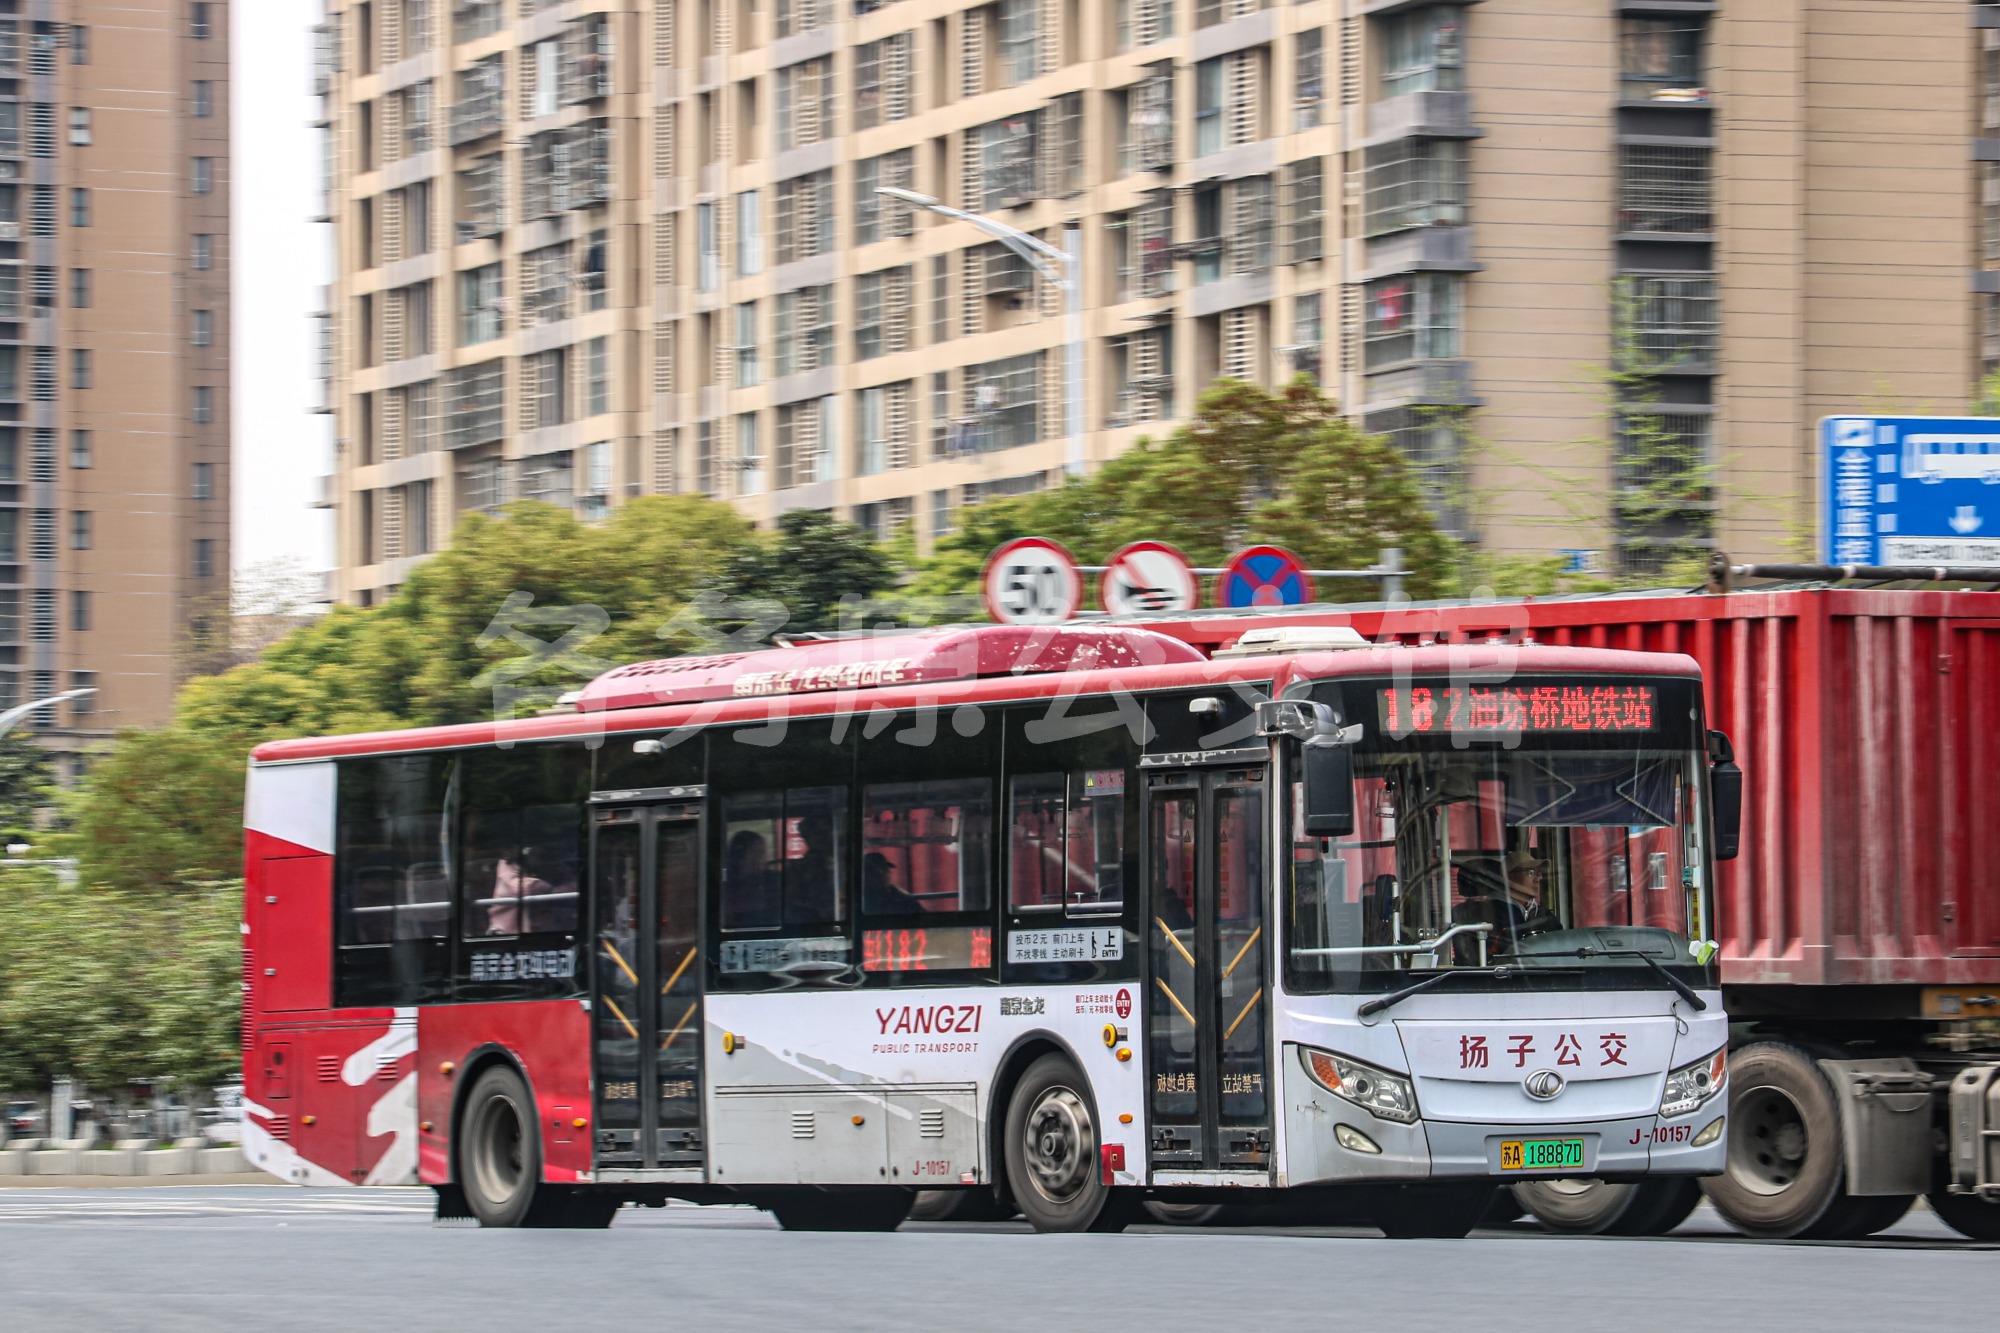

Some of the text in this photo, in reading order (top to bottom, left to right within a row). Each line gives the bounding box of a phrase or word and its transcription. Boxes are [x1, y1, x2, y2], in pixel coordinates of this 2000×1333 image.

[1000, 564, 1070, 615] 50
[1384, 686, 1653, 731] 182 油坊桥地铁站
[1015, 932, 1085, 945] 投币2元 前门上车
[1104, 930, 1116, 947] 上
[1052, 948, 1085, 959] 主动刷卡
[1101, 949, 1119, 958] ENTRY
[1000, 997, 1045, 1016] 南京金龙
[876, 1005, 982, 1035] YANGZI
[872, 1042, 979, 1054] PUBLIC TRANSPORT
[1460, 1033, 1628, 1069] 扬子公交
[1629, 1126, 1692, 1145] J-10157
[1503, 1143, 1582, 1165] 苏A 18887D
[912, 1160, 950, 1176] J-10157
